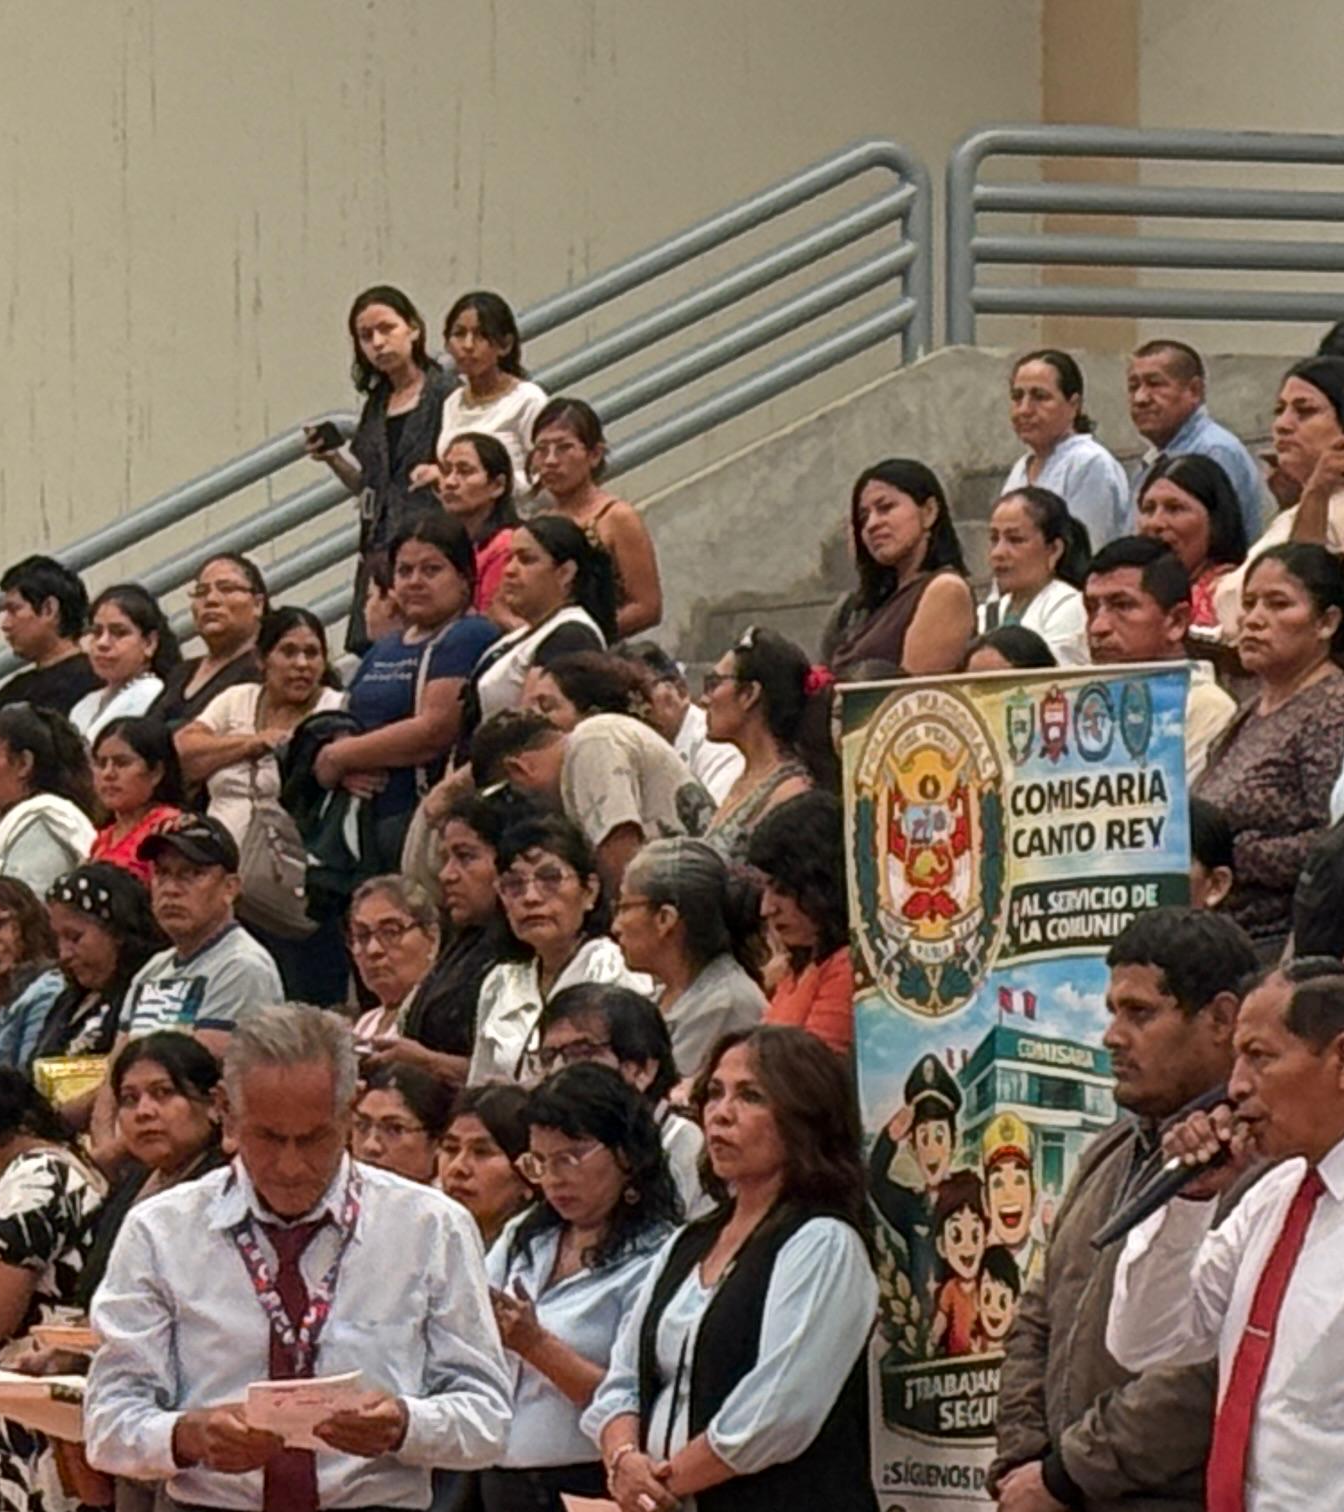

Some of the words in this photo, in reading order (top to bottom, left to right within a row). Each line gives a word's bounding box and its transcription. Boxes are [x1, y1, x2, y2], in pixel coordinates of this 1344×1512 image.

[1012, 821, 1096, 859] CANTO
[1106, 816, 1166, 850] REY
[1047, 886, 1128, 914] SERVICIO
[1131, 883, 1159, 907] DE
[1019, 919, 1042, 943] LA
[1046, 912, 1136, 942] COMUNID
